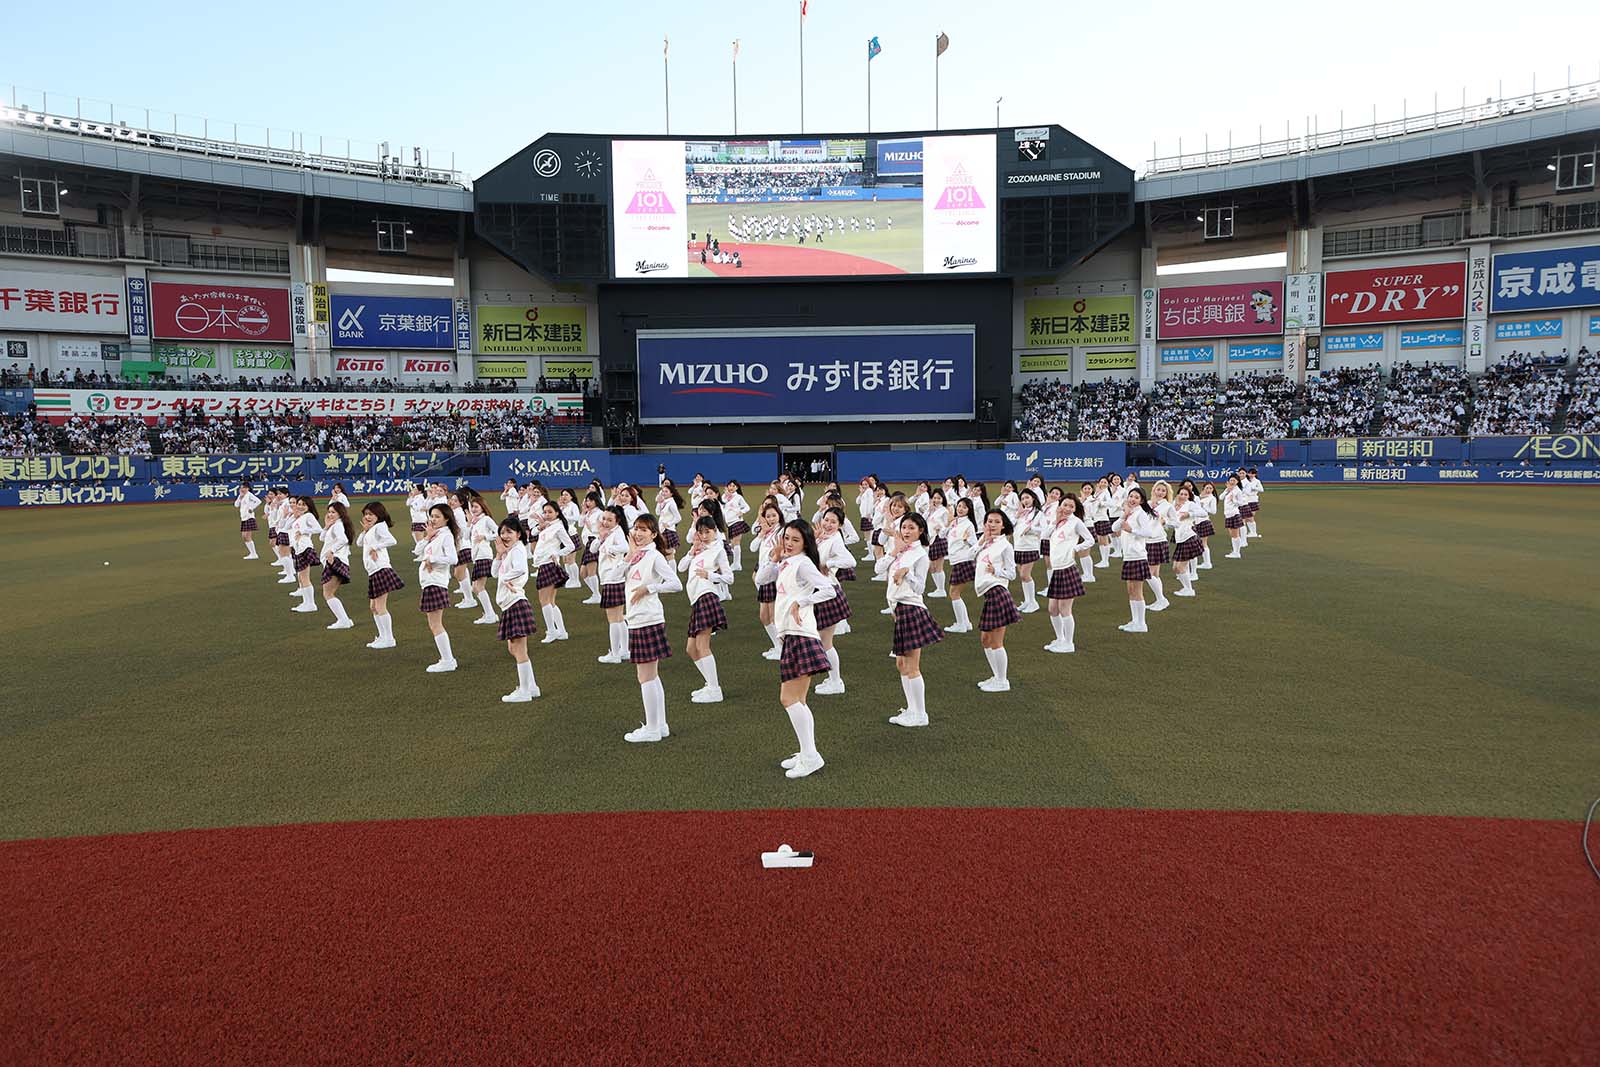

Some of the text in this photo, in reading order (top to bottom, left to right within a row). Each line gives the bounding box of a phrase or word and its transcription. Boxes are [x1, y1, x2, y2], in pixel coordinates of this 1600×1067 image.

[1008, 171, 1100, 184] ZOZOMARINE STADIUM
[540, 193, 559, 201] TIME
[637, 193, 664, 208] 101
[946, 187, 973, 202] 101
[635, 260, 669, 273] Marines
[944, 256, 977, 268] Marines
[1372, 274, 1424, 288] SUPER
[1472, 258, 1485, 301] 京成バス
[0, 288, 120, 315] 千葉銀行
[314, 286, 328, 323] 加治屋
[1204, 294, 1245, 302] Marines!
[1308, 285, 1317, 321] 吉田工業
[1163, 303, 1245, 327] ちば興銀
[378, 314, 450, 333] 京葉銀行
[458, 313, 470, 350] 大森工業
[1030, 314, 1130, 335] 新日本建設
[339, 331, 364, 339] BANK
[482, 323, 582, 342] 新日本建設
[1472, 324, 1482, 341] coly
[1031, 338, 1080, 346] INTELLIGENT
[236, 359, 266, 367] 保育園
[659, 363, 769, 385] MIZUHO
[786, 358, 954, 392] みずほ銀行
[1362, 439, 1434, 457] 新昭和
[161, 455, 304, 477] 東京インテリア
[527, 459, 590, 472] KAKUTA
[1043, 458, 1104, 468] 三井住友銀行
[1360, 468, 1406, 480] 新昭和
[1497, 470, 1600, 480] イオンモール幕張新都心
[19, 487, 125, 505] 東進ハイスクール
